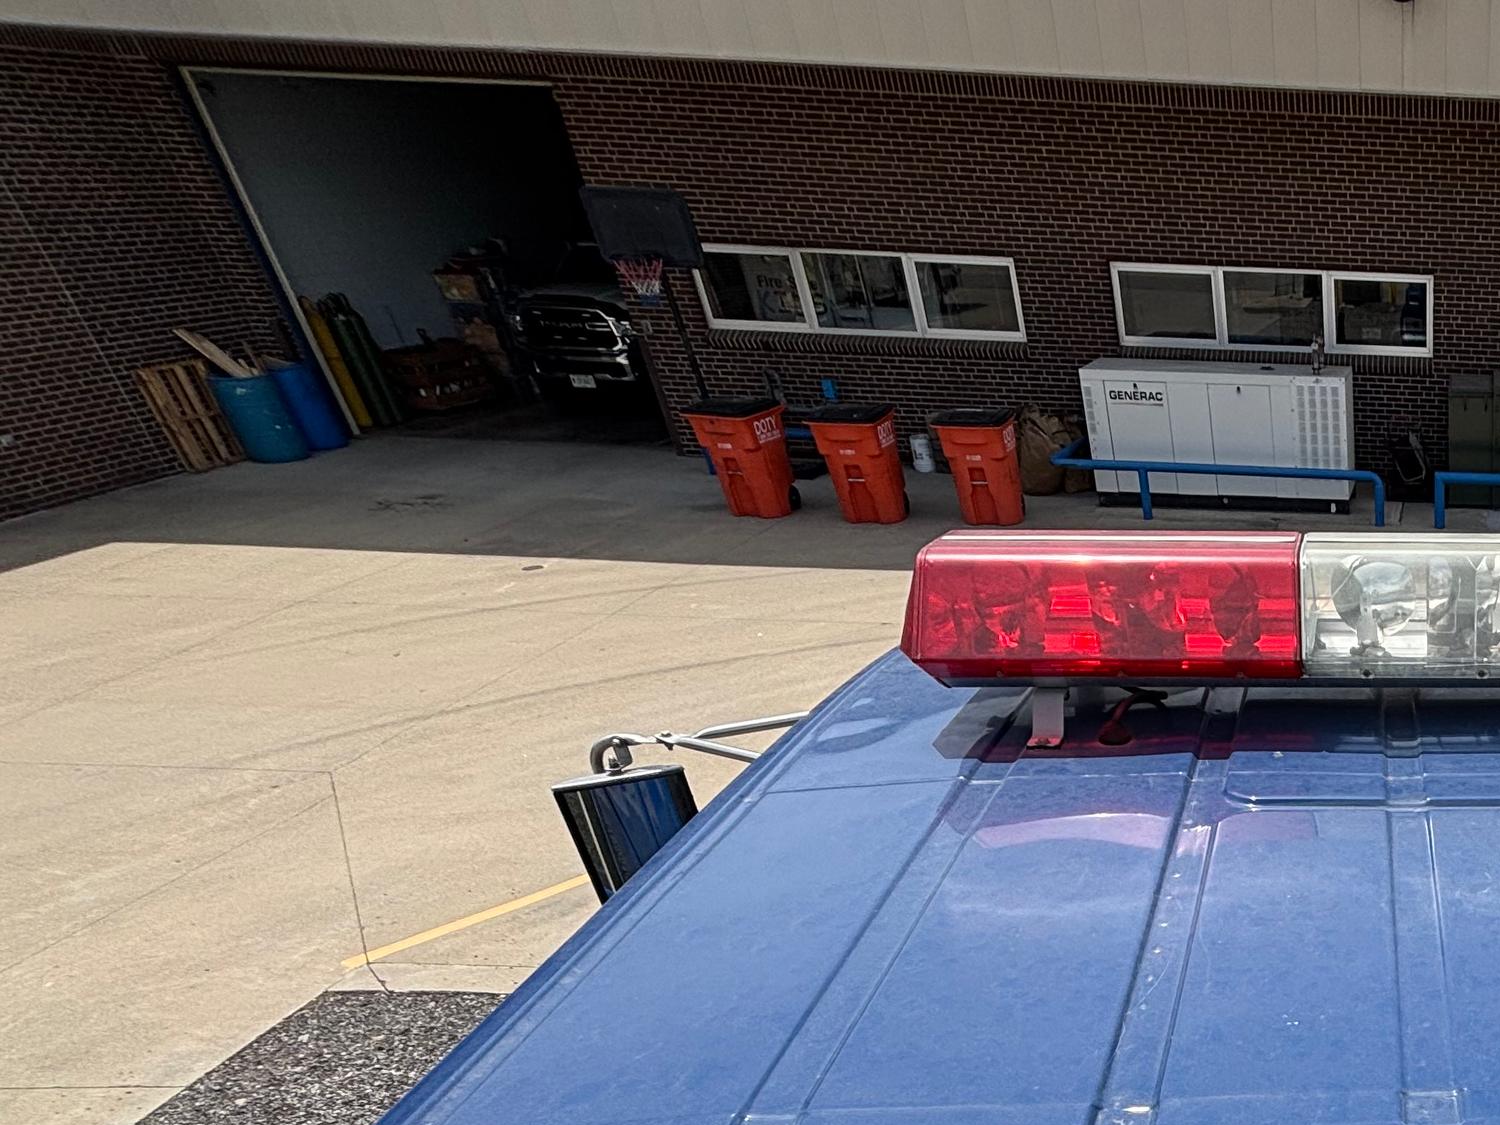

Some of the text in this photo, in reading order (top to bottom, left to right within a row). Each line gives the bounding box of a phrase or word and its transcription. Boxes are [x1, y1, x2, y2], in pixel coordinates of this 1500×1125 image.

[756, 275, 818, 290] Fire Se
[1109, 390, 1163, 401] GENERAC
[753, 415, 777, 436] DOTY
